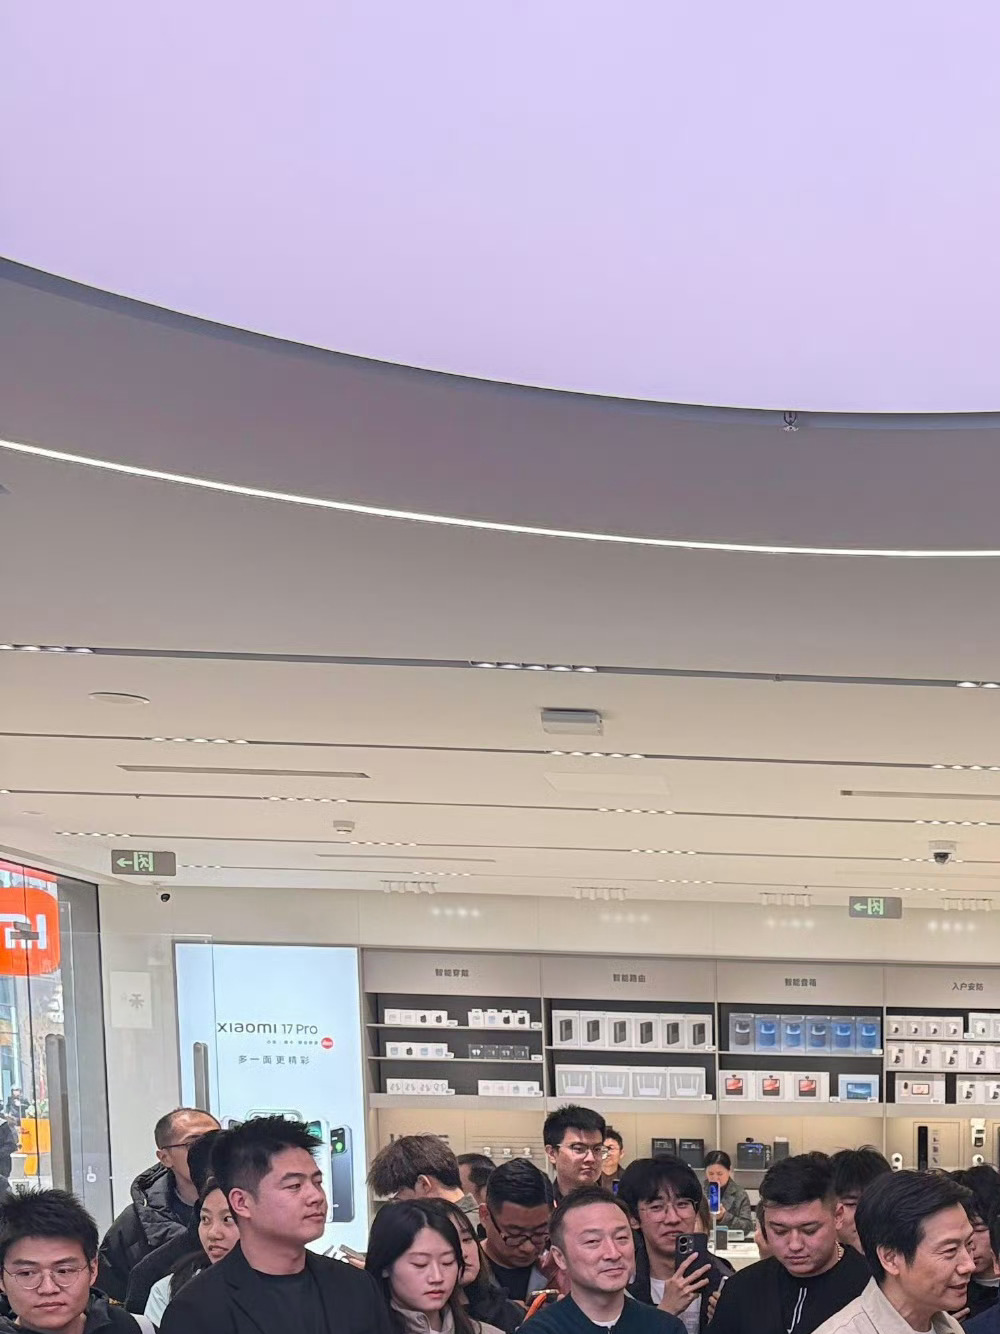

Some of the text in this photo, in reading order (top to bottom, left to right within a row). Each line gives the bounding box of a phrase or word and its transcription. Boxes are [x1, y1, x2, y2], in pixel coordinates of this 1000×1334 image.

[613, 973, 646, 983] 智能路由
[784, 977, 817, 987] 智能音箱
[952, 982, 984, 991] 入户安防
[281, 1023, 293, 1034] 17
[296, 1024, 318, 1035] Pro
[238, 1055, 310, 1065] 多一面更精彩
